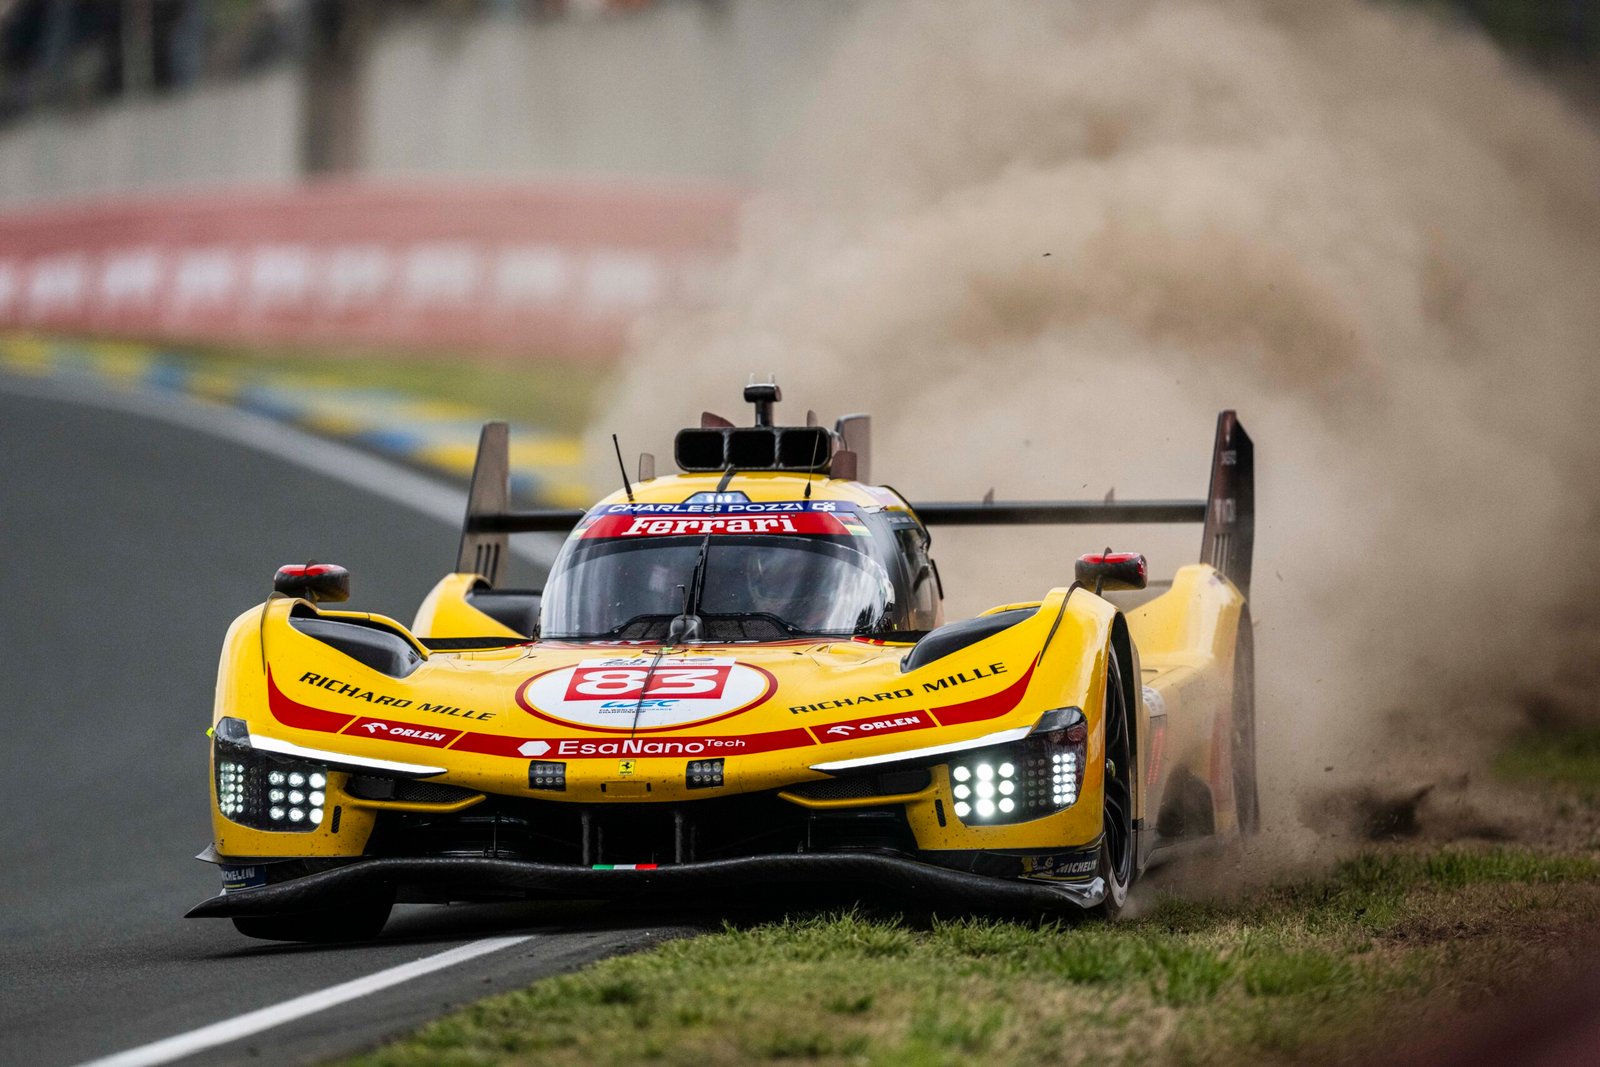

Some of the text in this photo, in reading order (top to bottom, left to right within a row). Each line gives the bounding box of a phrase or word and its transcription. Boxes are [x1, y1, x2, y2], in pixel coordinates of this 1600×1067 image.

[608, 503, 804, 513] CHARLES POZZI
[621, 515, 798, 536] Ferrari
[575, 668, 720, 695] 83
[789, 662, 1008, 715] RICHARD MILLE
[299, 671, 497, 721] RICHARD MILLE
[389, 727, 446, 742] ORLEN
[859, 716, 921, 732] ORLEN
